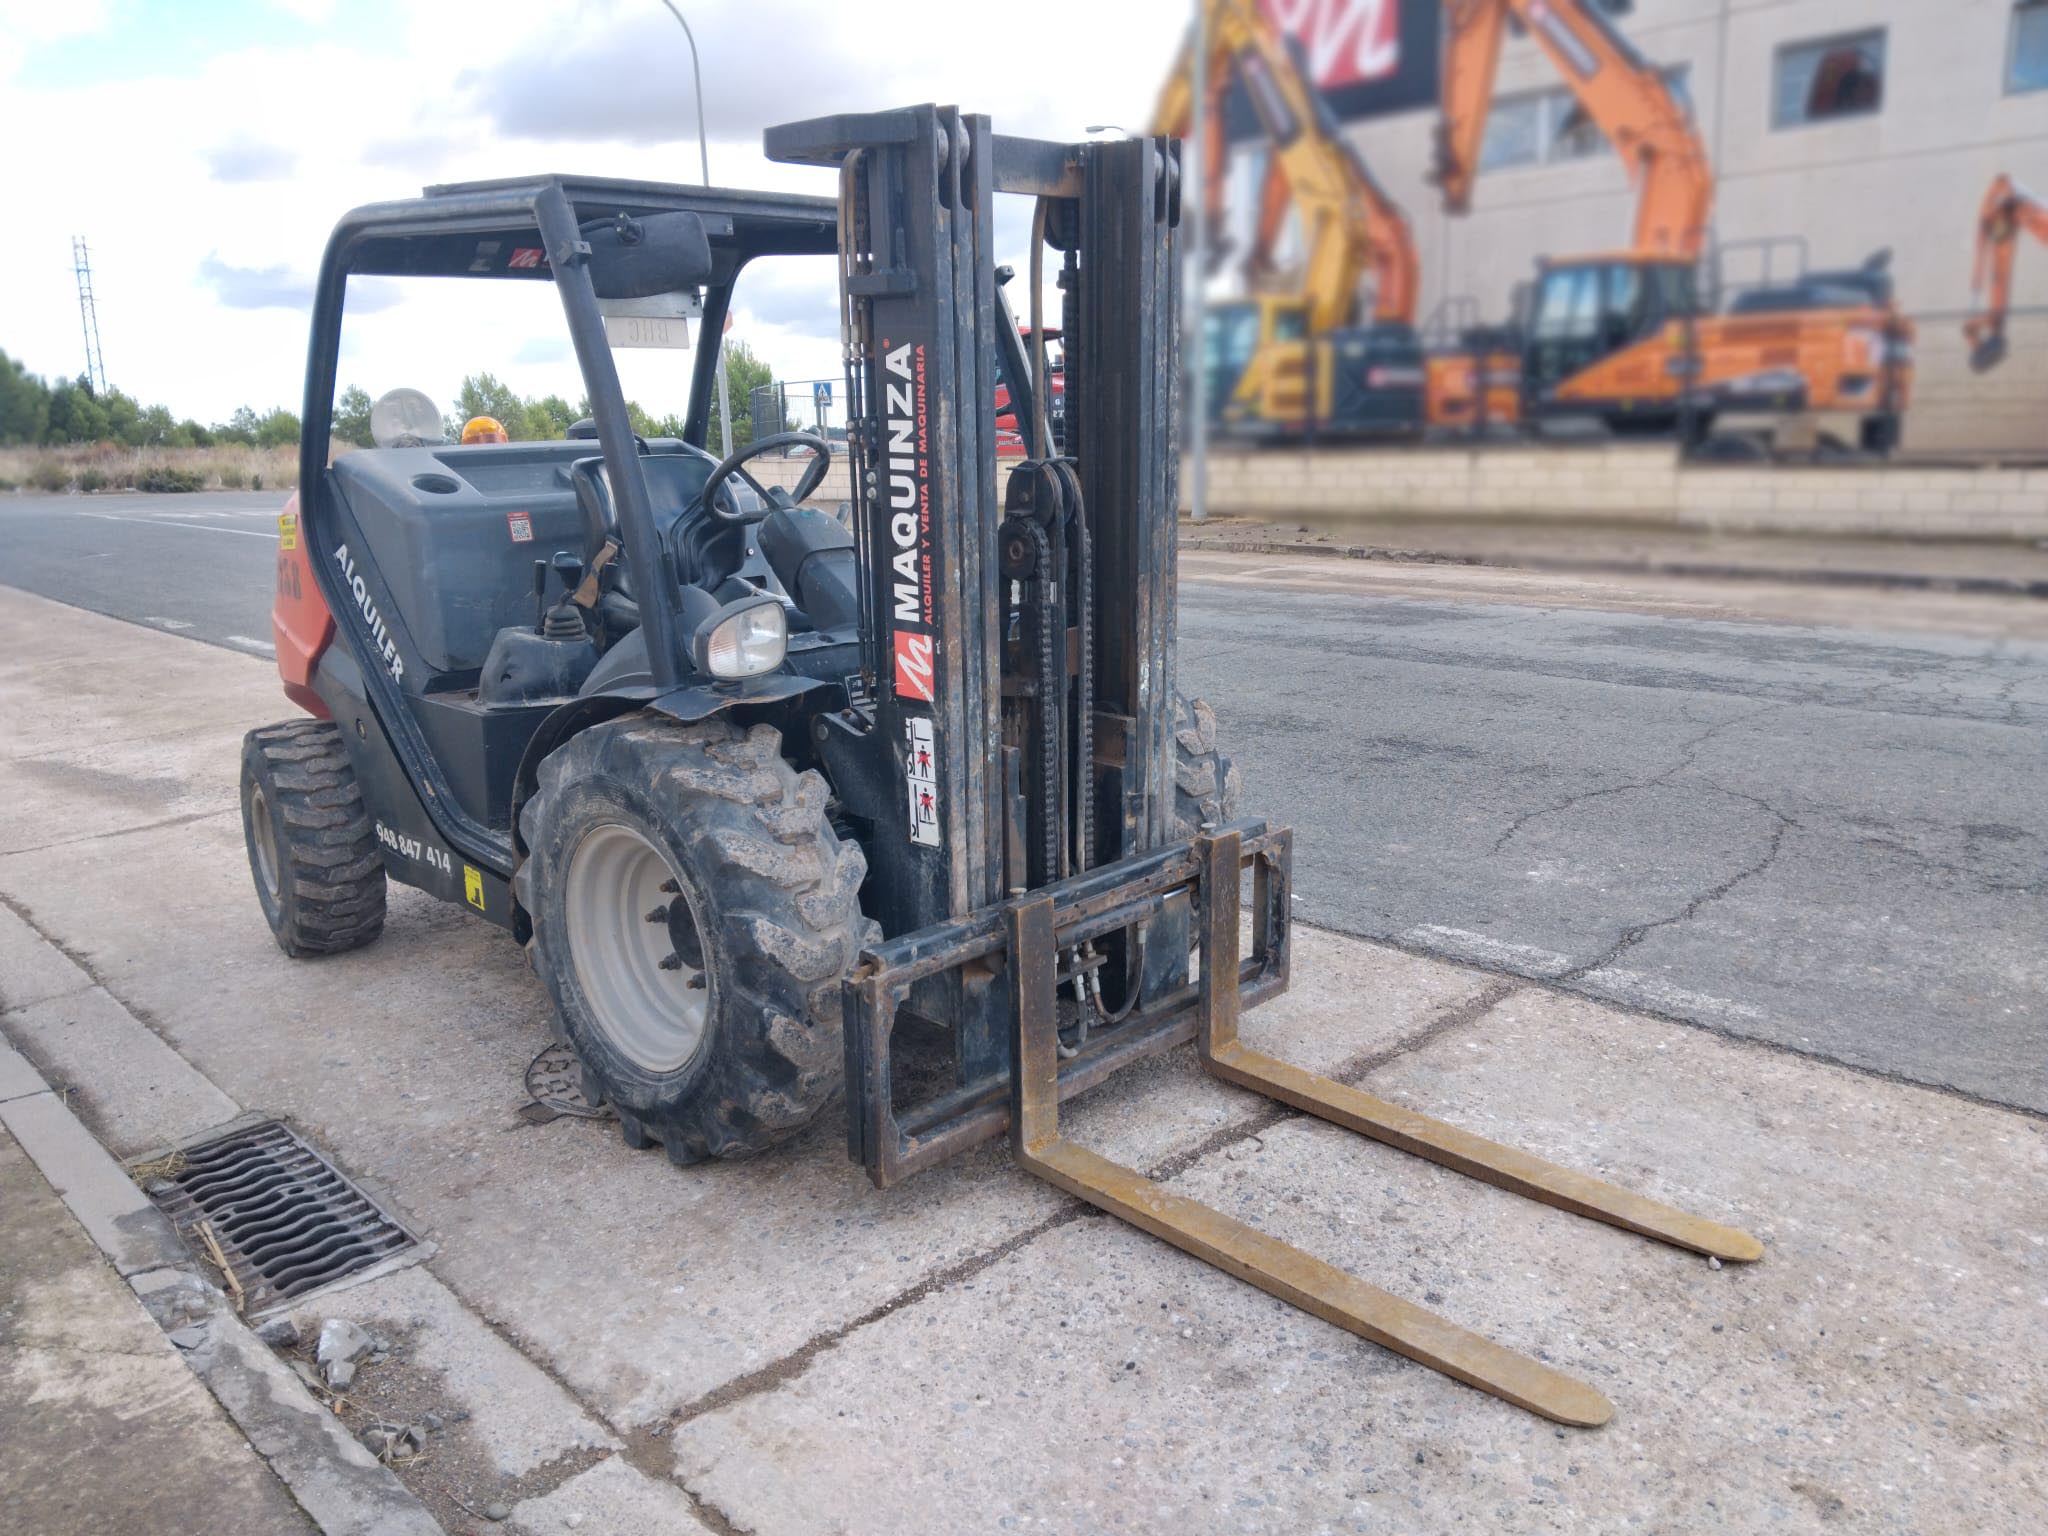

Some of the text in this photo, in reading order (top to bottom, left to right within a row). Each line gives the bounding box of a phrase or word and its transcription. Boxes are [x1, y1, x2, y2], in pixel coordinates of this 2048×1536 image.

[885, 342, 919, 623] MAQUINZA
[916, 344, 933, 625] ALQUILER Y VENTA DE MAQUINARIA
[333, 543, 404, 686] ALQUILER
[375, 822, 398, 850] 948
[398, 834, 421, 860] 847
[426, 846, 452, 873] 414
